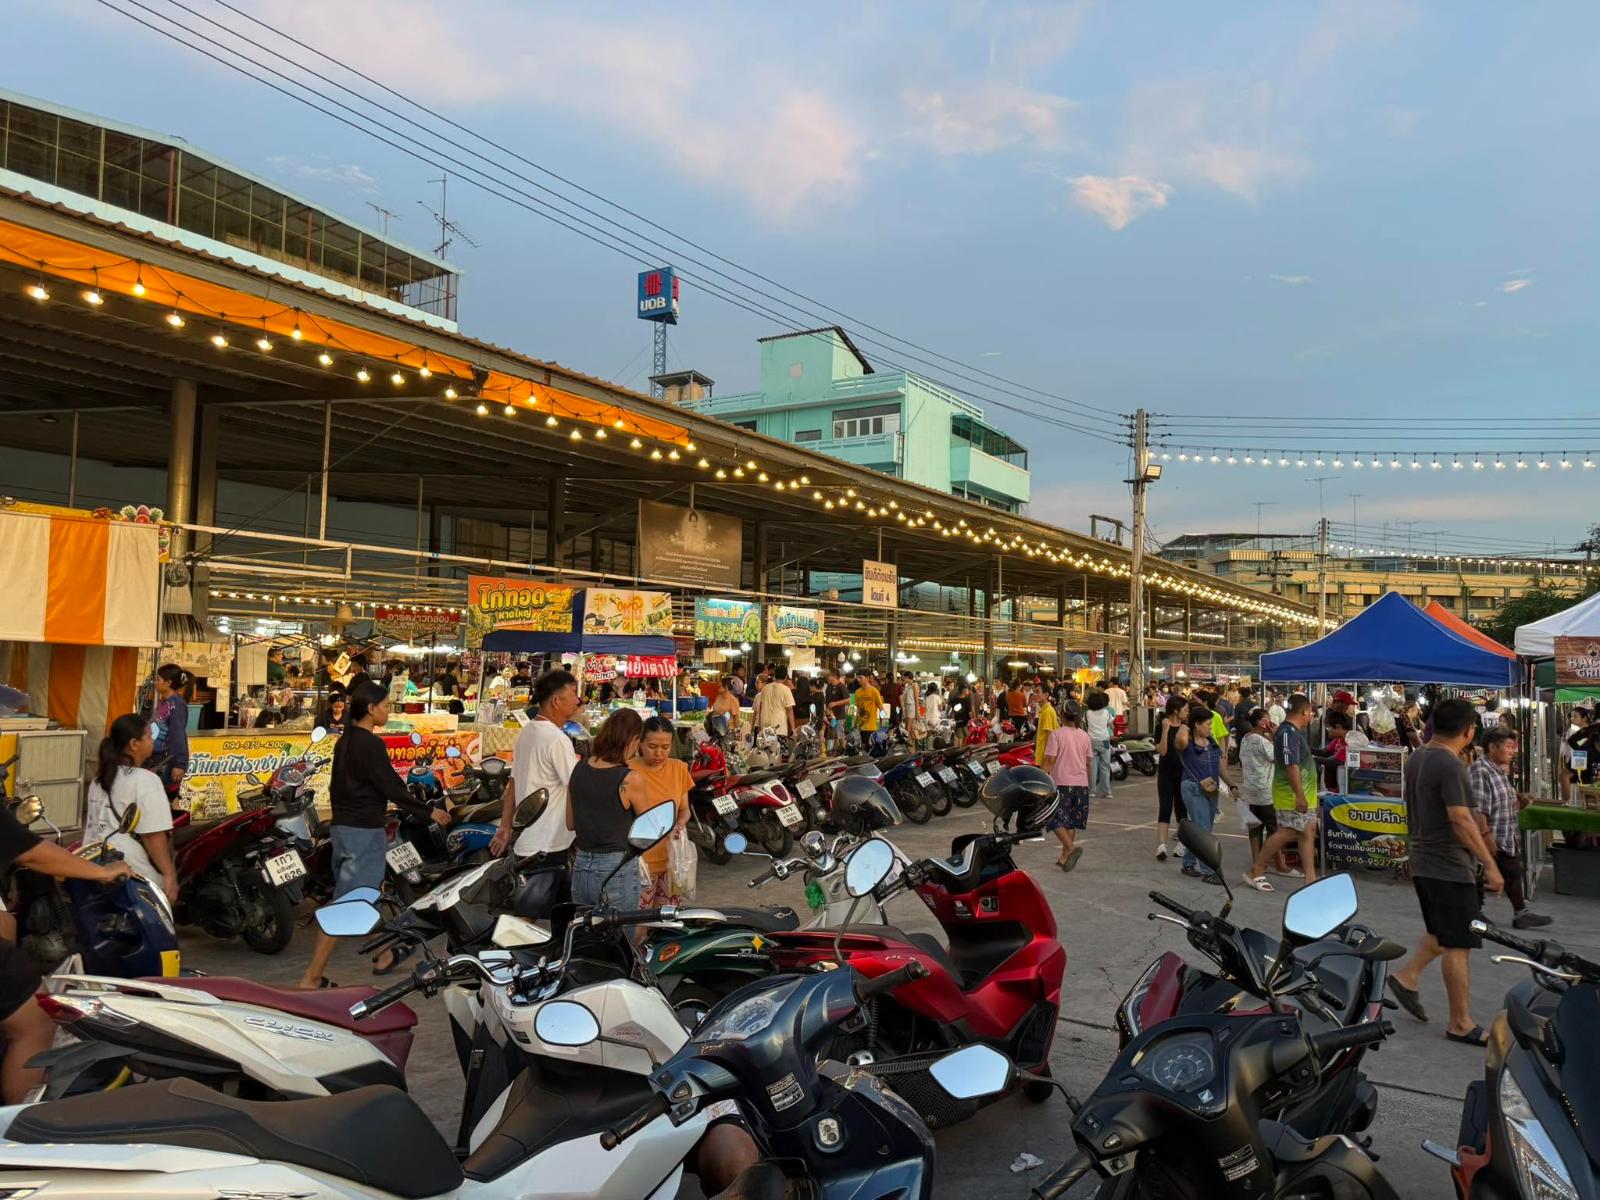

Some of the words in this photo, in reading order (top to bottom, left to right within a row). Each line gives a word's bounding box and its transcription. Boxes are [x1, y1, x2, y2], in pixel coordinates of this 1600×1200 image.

[640, 296, 666, 312] UOB
[479, 582, 545, 611] ไก่ทอด
[223, 741, 285, 750] 094-979-4300
